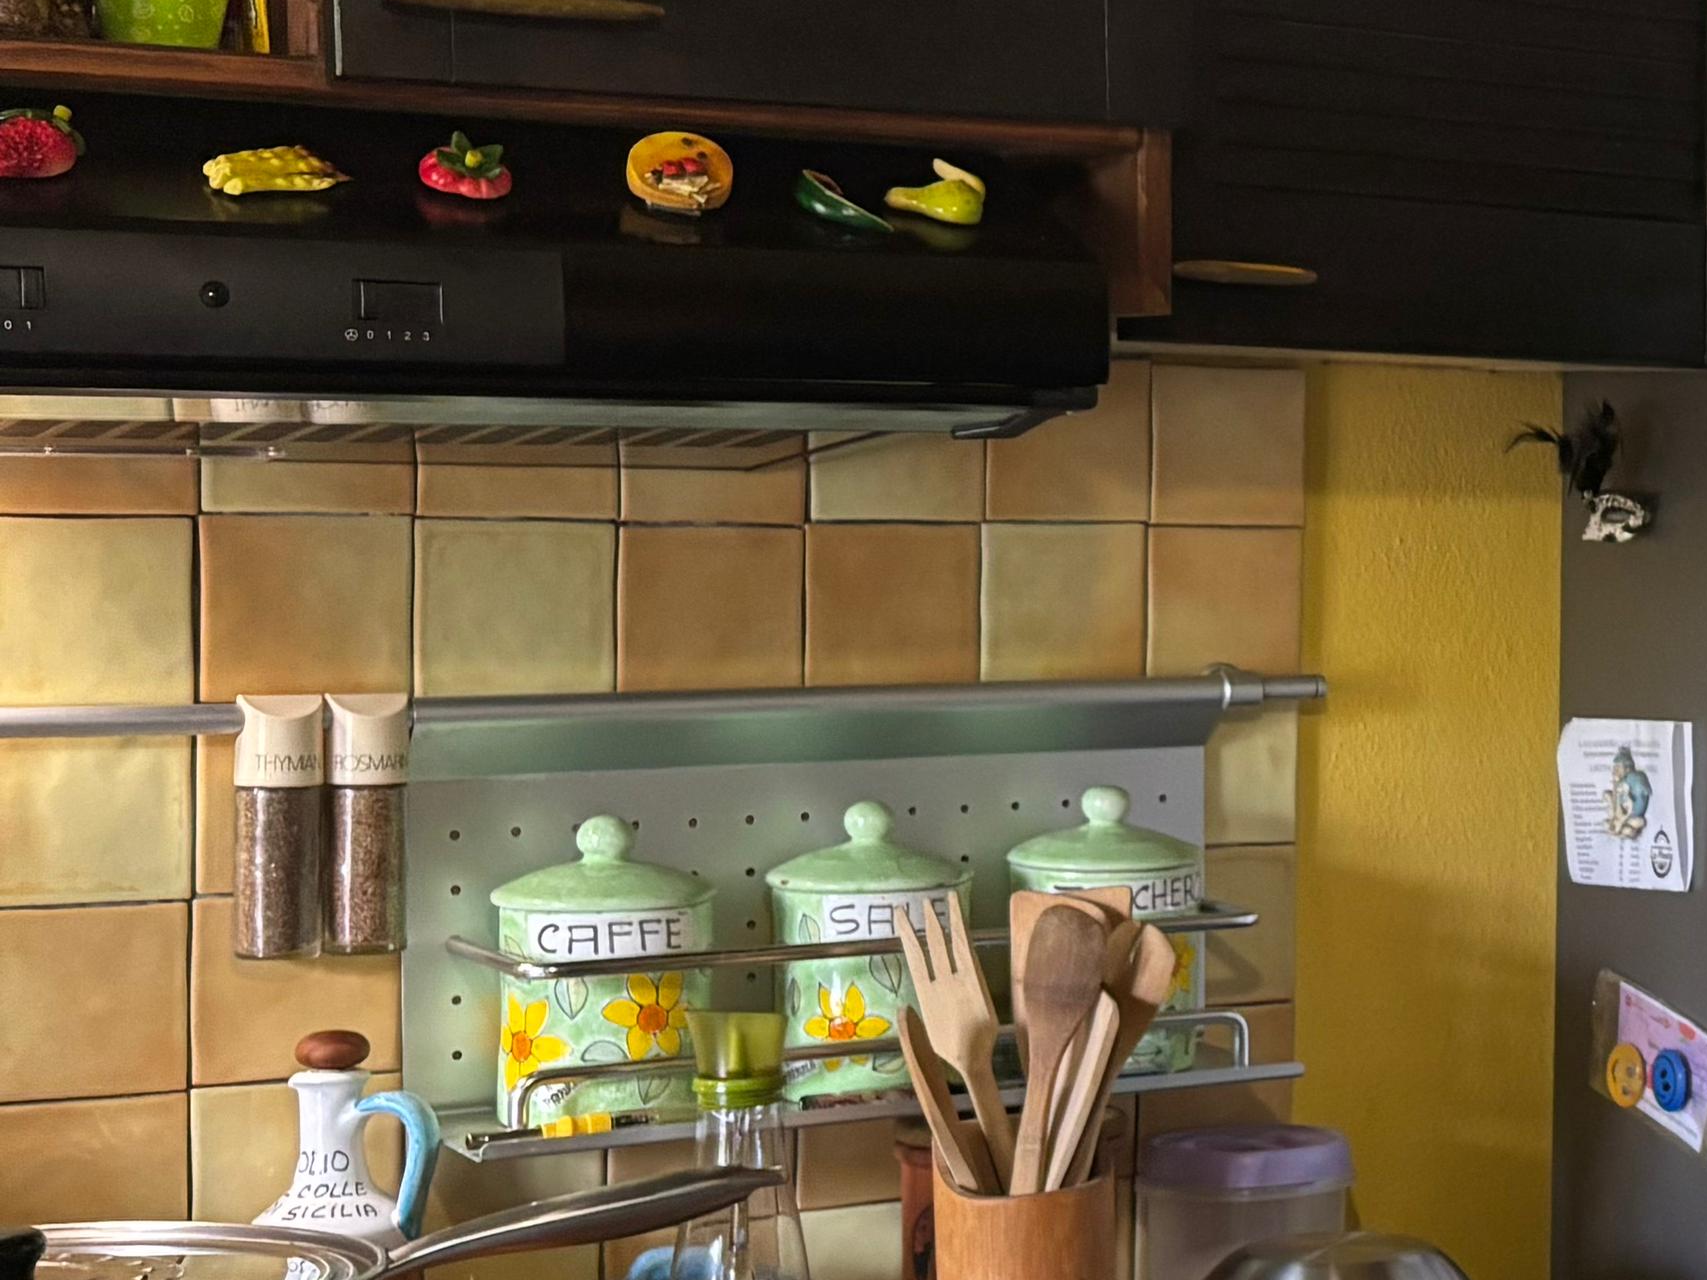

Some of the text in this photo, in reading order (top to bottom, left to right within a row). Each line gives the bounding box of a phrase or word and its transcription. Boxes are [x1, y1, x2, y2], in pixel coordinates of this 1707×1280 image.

[298, 1150, 350, 1176] OLIO
[297, 1181, 369, 1200] COLLE
[281, 1202, 378, 1222] SICILIA
